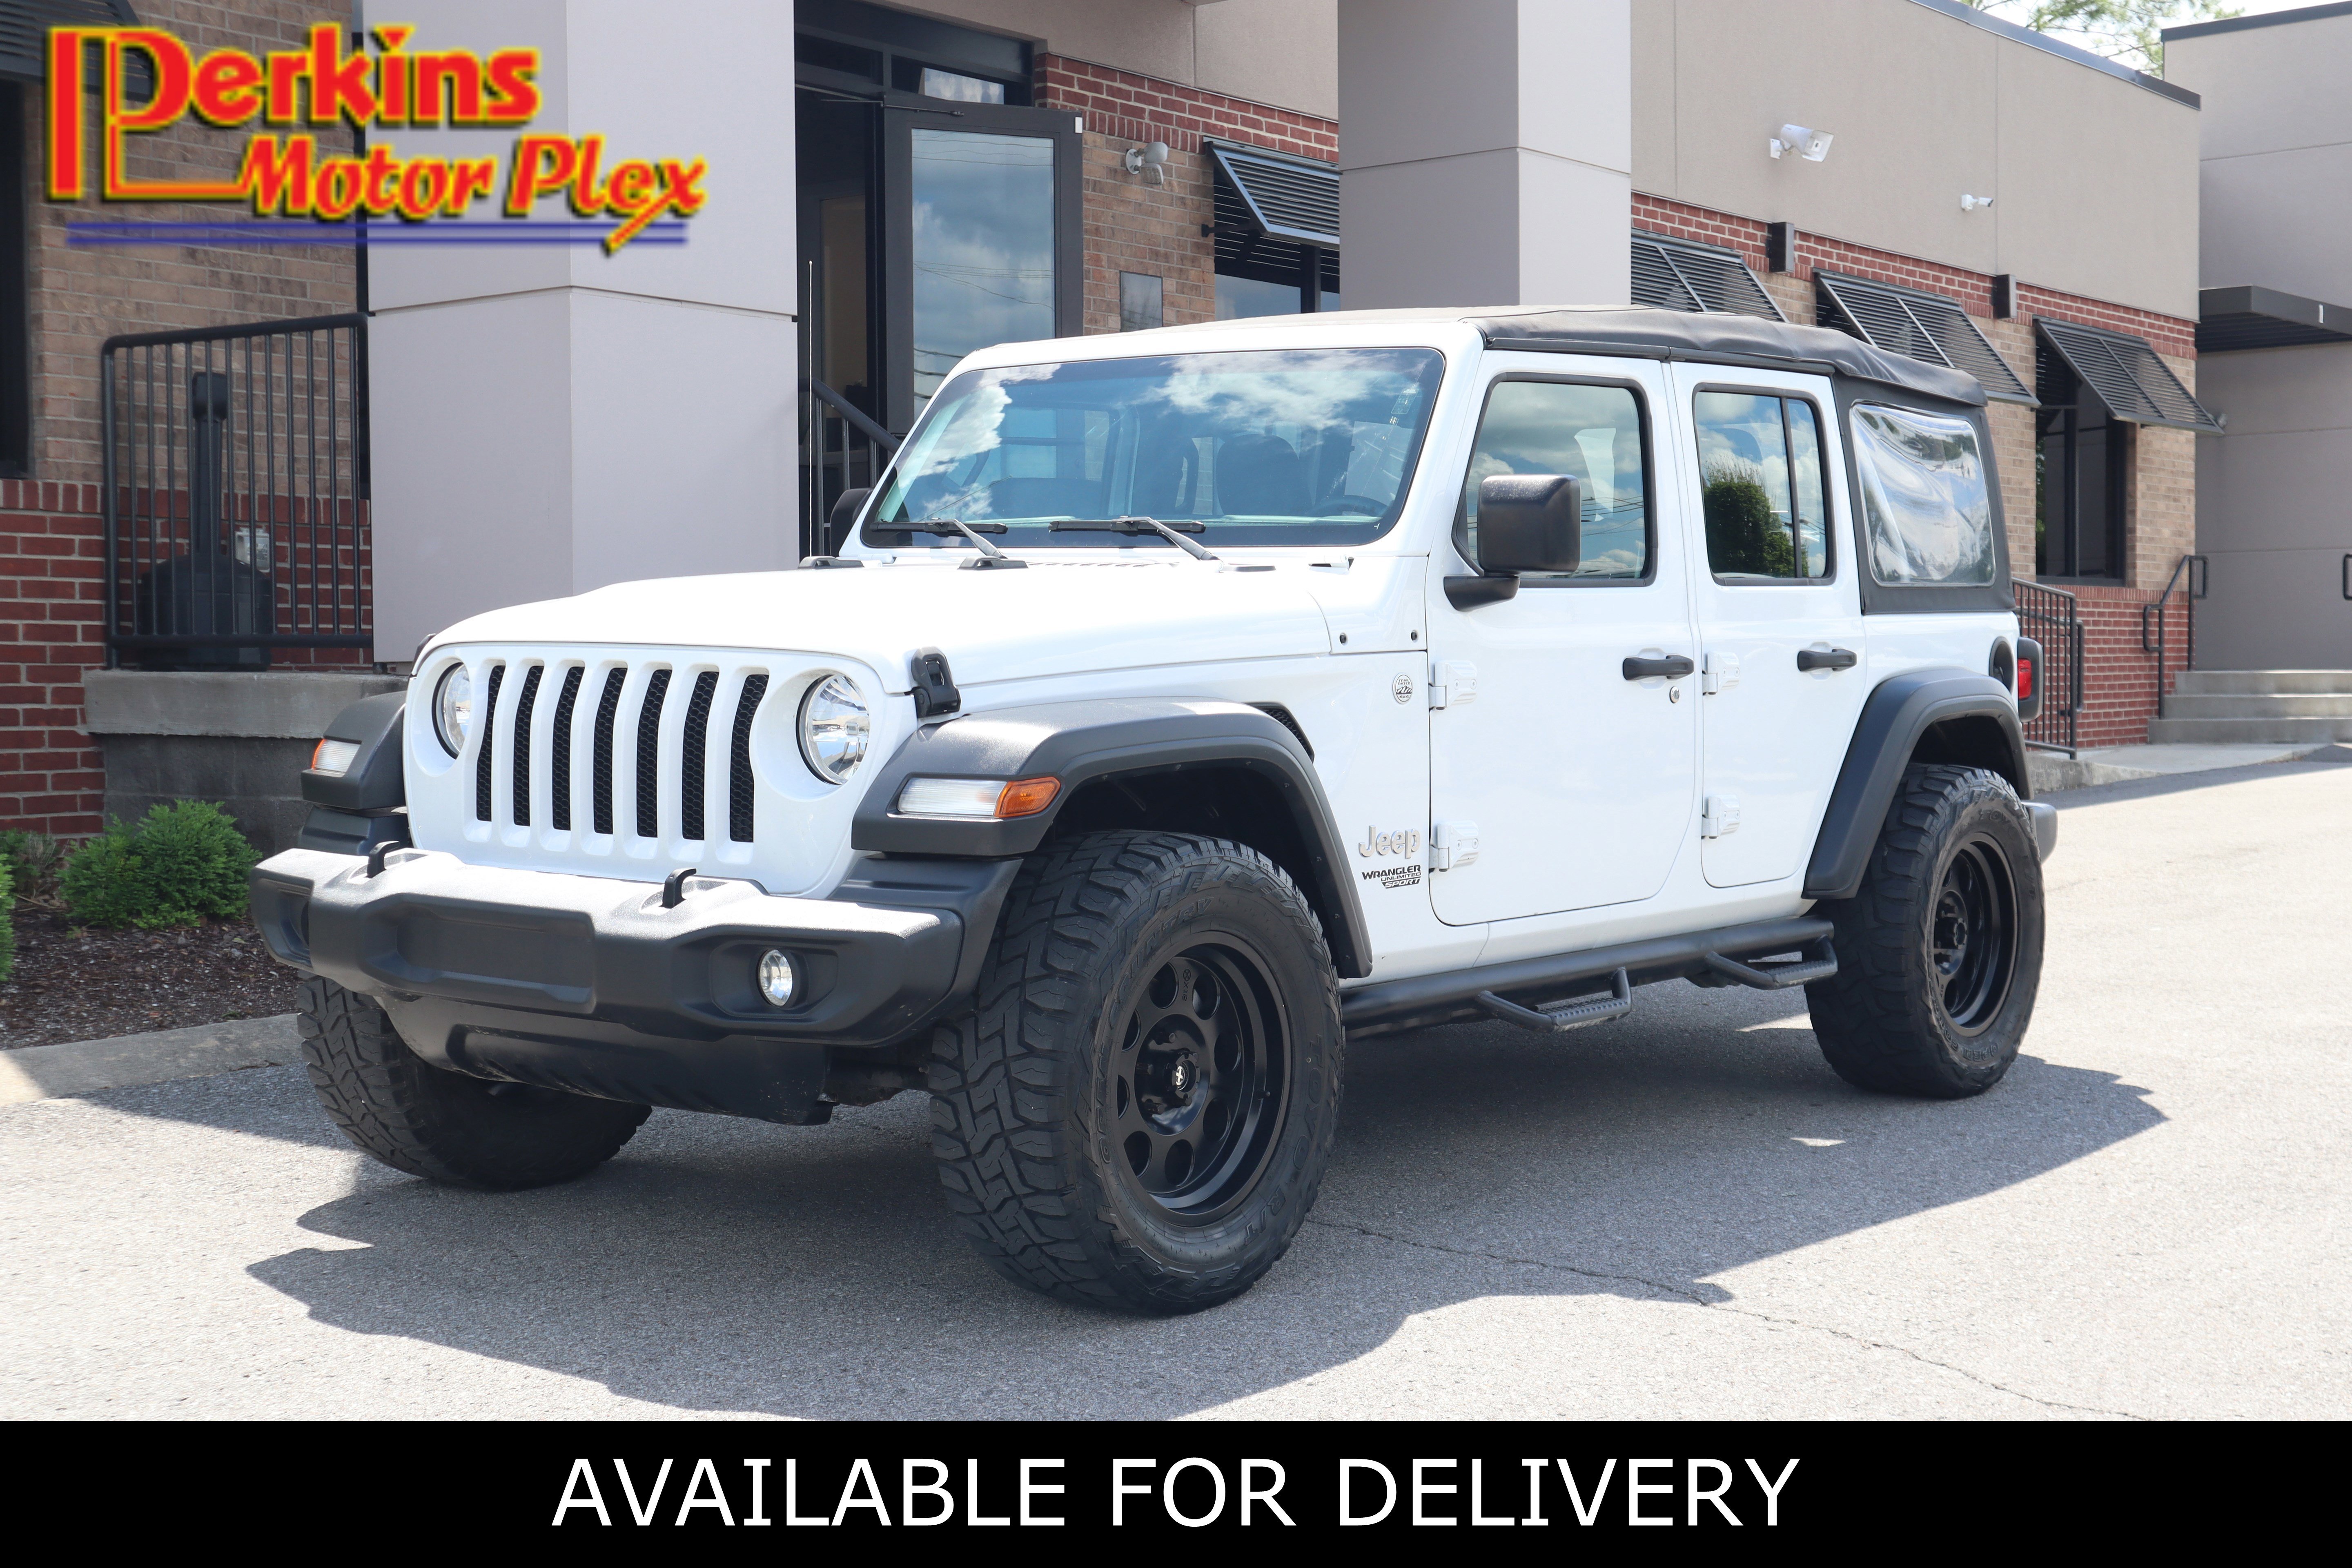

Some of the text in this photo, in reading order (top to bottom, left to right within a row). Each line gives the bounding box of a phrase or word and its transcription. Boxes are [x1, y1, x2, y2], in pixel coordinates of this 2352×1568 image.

[1358, 824, 1421, 860] Jeep
[1361, 864, 1421, 880] WRANGLER
[1381, 872, 1421, 882] UNLIMITED
[1384, 878, 1421, 888] SPORT
[1293, 1033, 1323, 1171] TOYO
